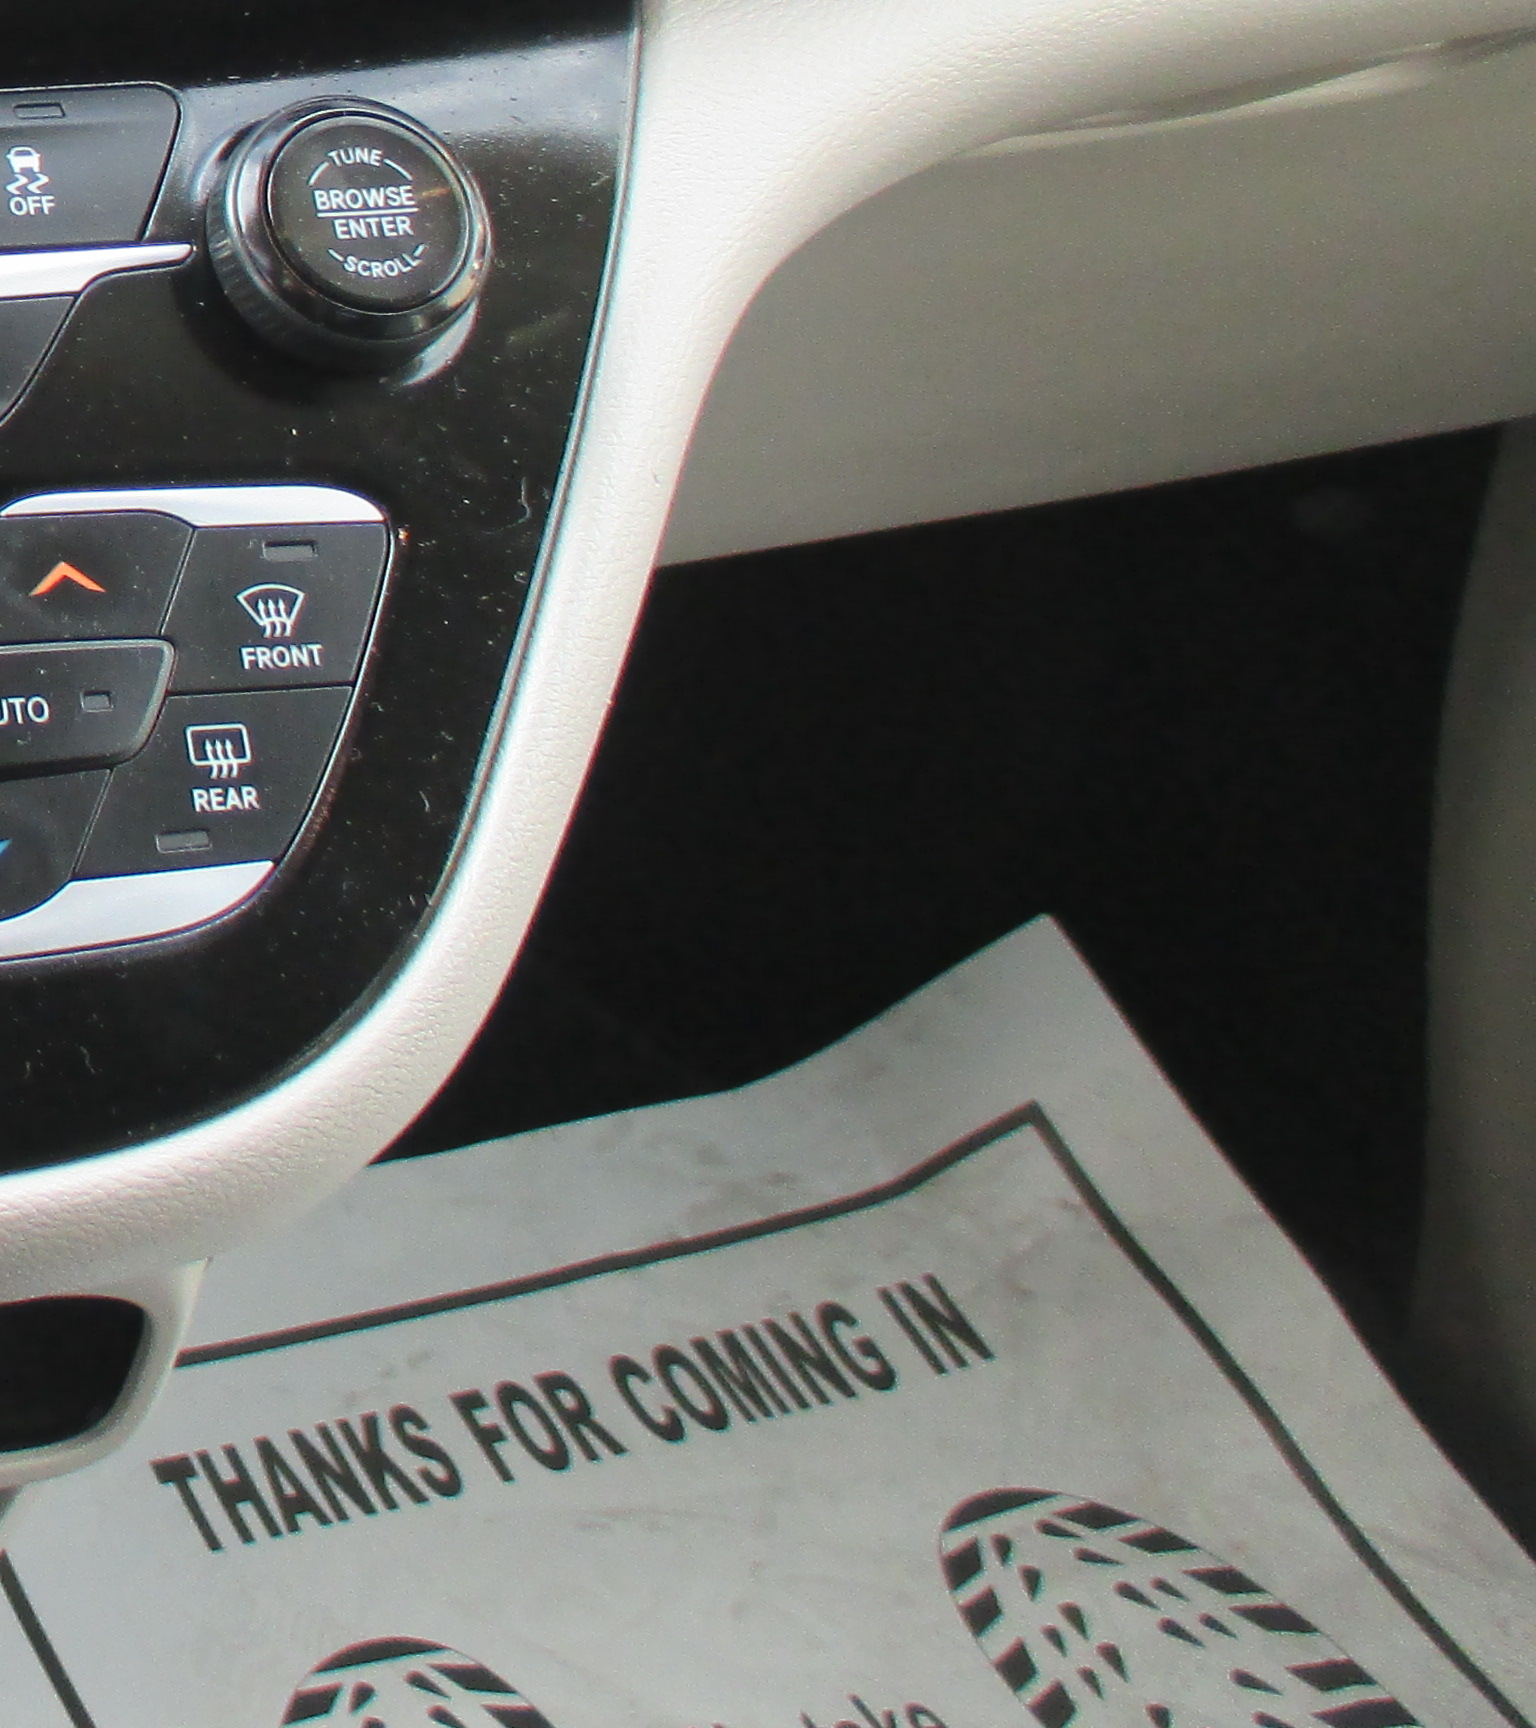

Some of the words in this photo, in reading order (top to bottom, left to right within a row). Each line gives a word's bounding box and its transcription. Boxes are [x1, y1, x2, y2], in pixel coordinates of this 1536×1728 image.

[327, 146, 383, 167] TUNE
[9, 195, 56, 216] OFF
[313, 184, 418, 211] BROWSE
[333, 215, 414, 240] ENTER
[342, 252, 419, 278] SCROLL
[240, 643, 323, 670] FRONT
[192, 785, 260, 813] REAR
[148, 1403, 463, 1553] THANKS
[447, 1370, 630, 1485] FOR
[607, 1299, 899, 1445] COMING
[877, 1271, 998, 1377] IN
